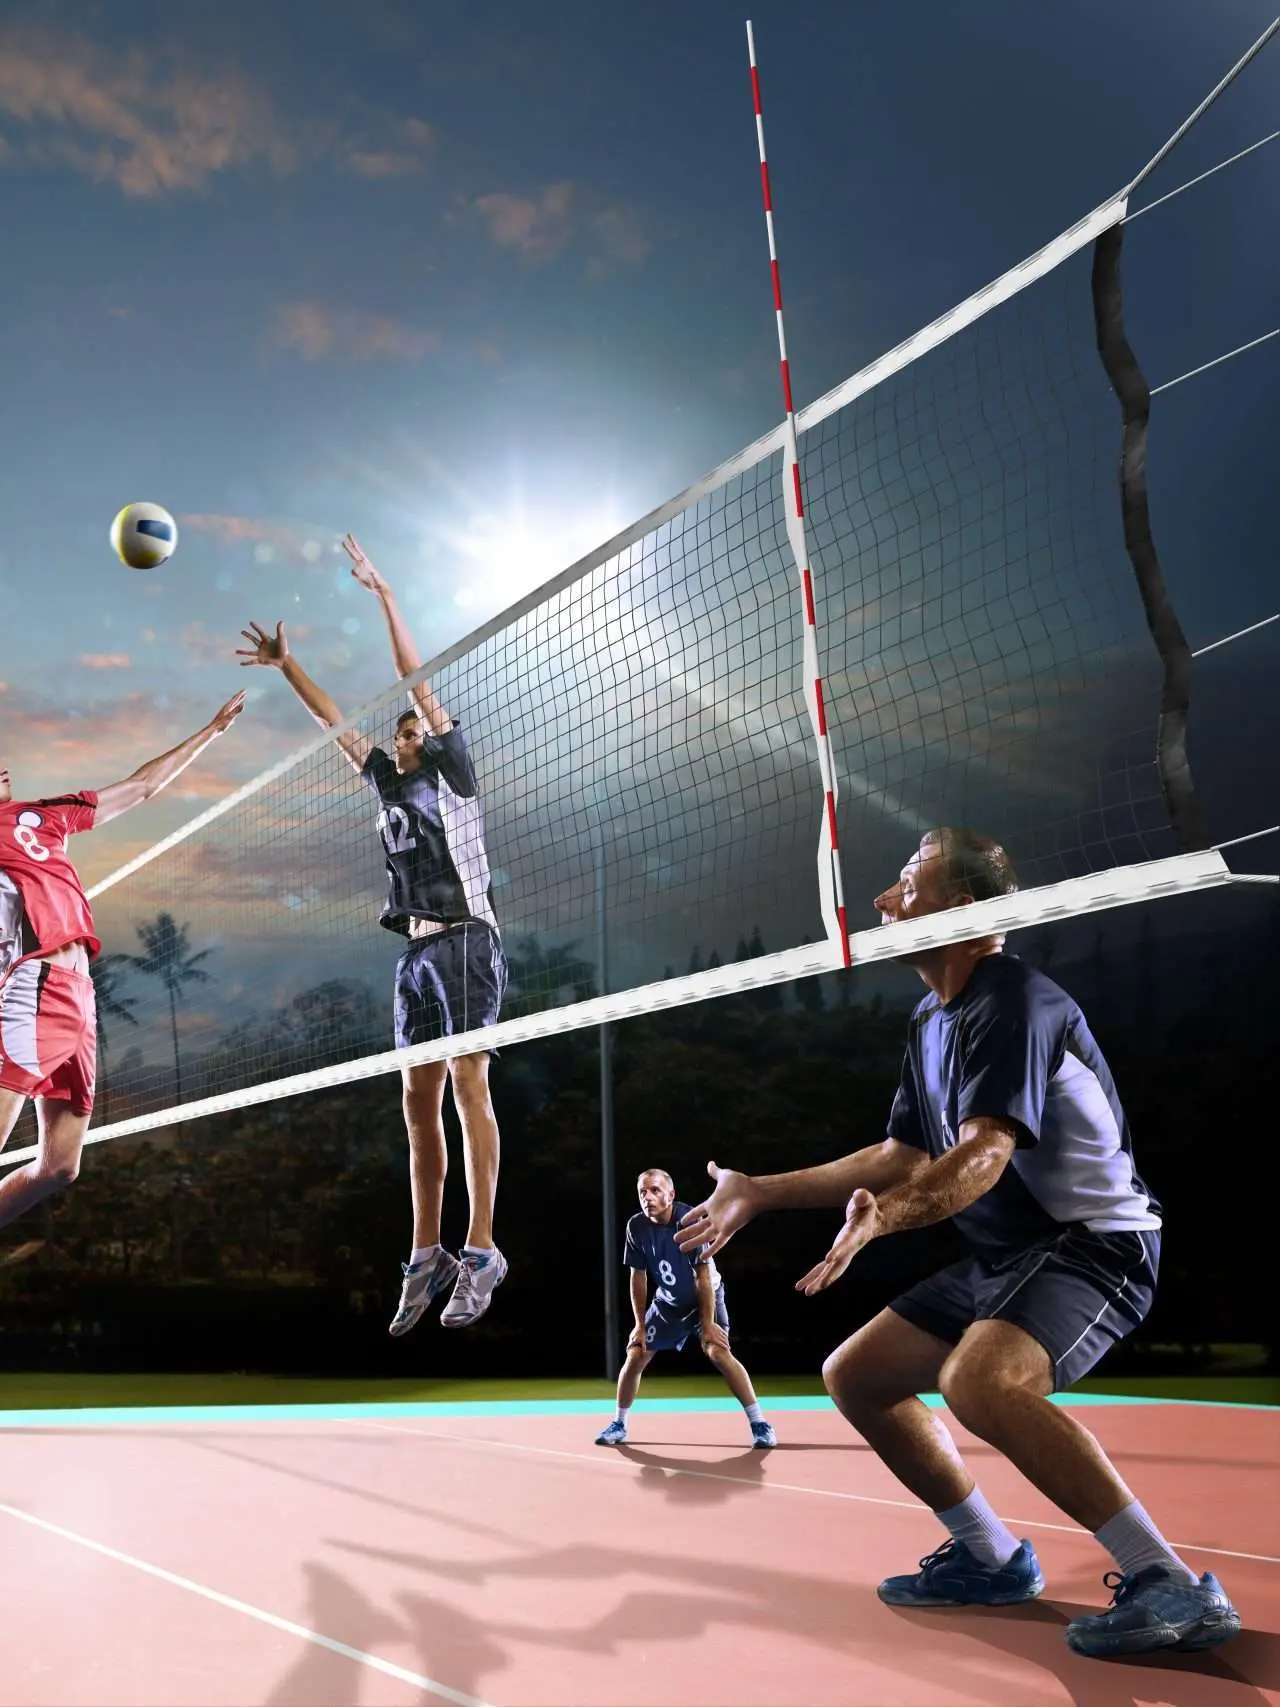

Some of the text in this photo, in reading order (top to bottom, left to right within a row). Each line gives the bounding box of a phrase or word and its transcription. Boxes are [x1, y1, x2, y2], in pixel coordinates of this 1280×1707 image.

[376, 806, 417, 855] 12
[658, 1259, 677, 1286] 8
[647, 1325, 657, 1343] 8
